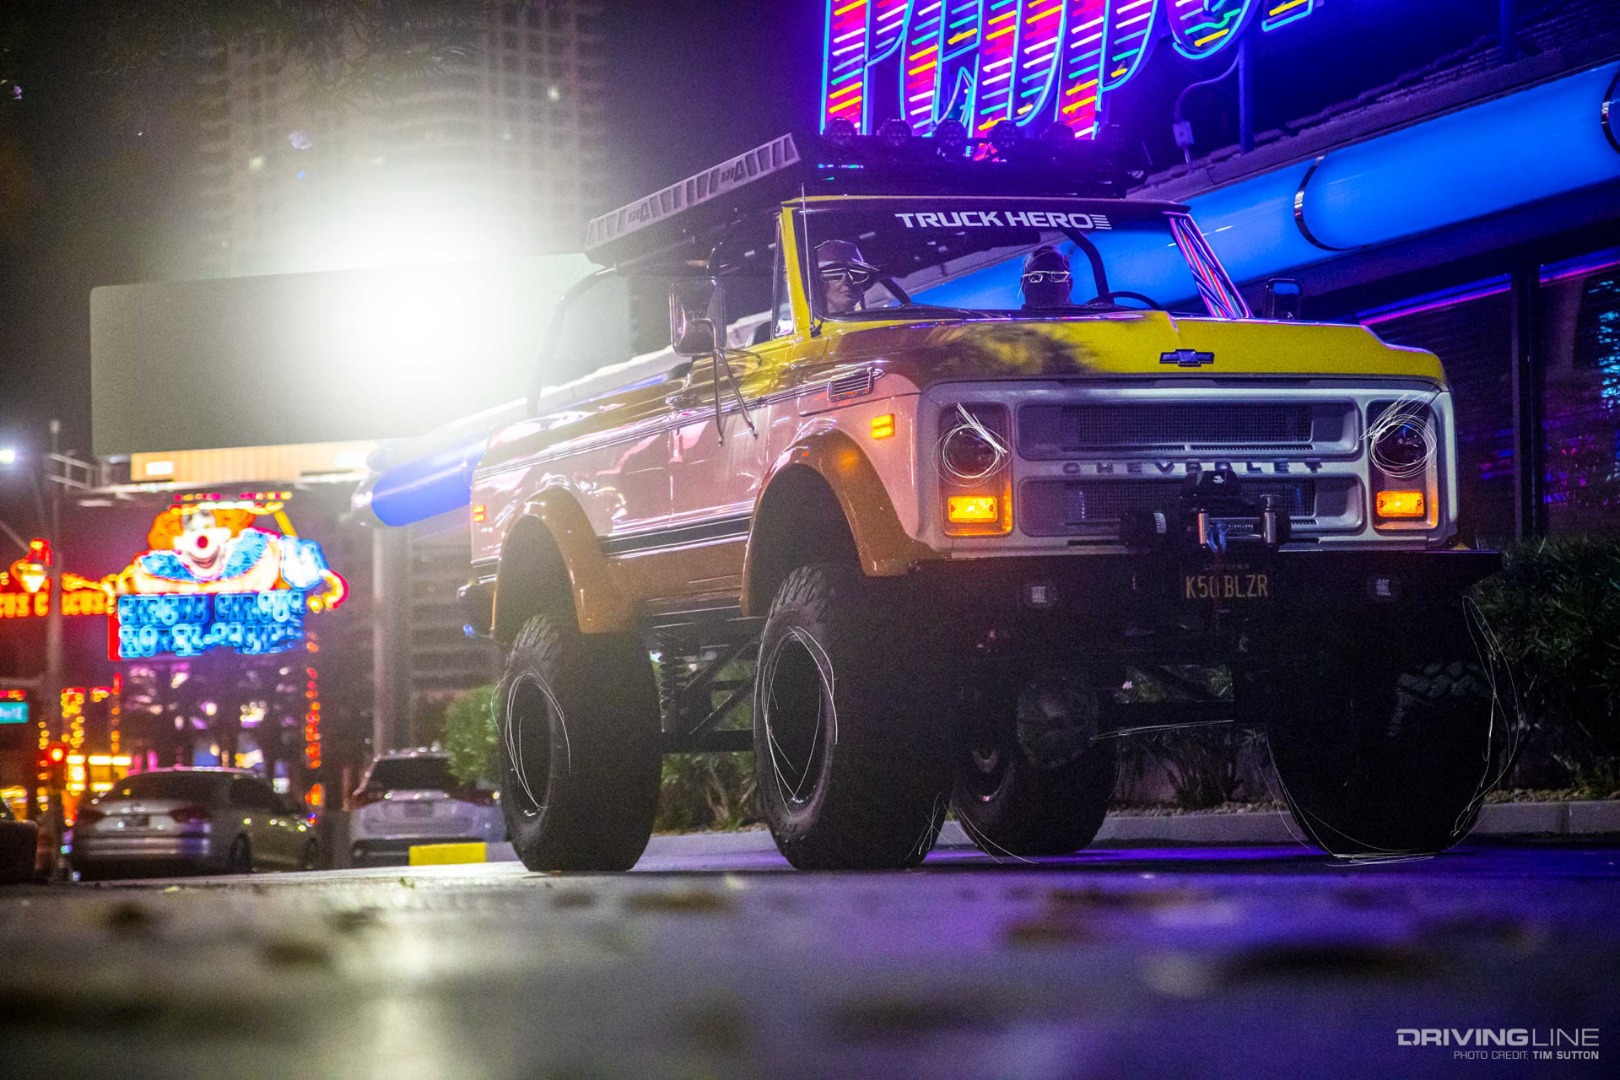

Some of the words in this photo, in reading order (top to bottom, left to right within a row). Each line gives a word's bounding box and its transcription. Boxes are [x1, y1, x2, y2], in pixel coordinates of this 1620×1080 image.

[895, 211, 1004, 228] TRUCK
[1004, 211, 1095, 229] HERO
[1062, 459, 1322, 475] CHEVROLET
[1223, 574, 1269, 598] BLZR
